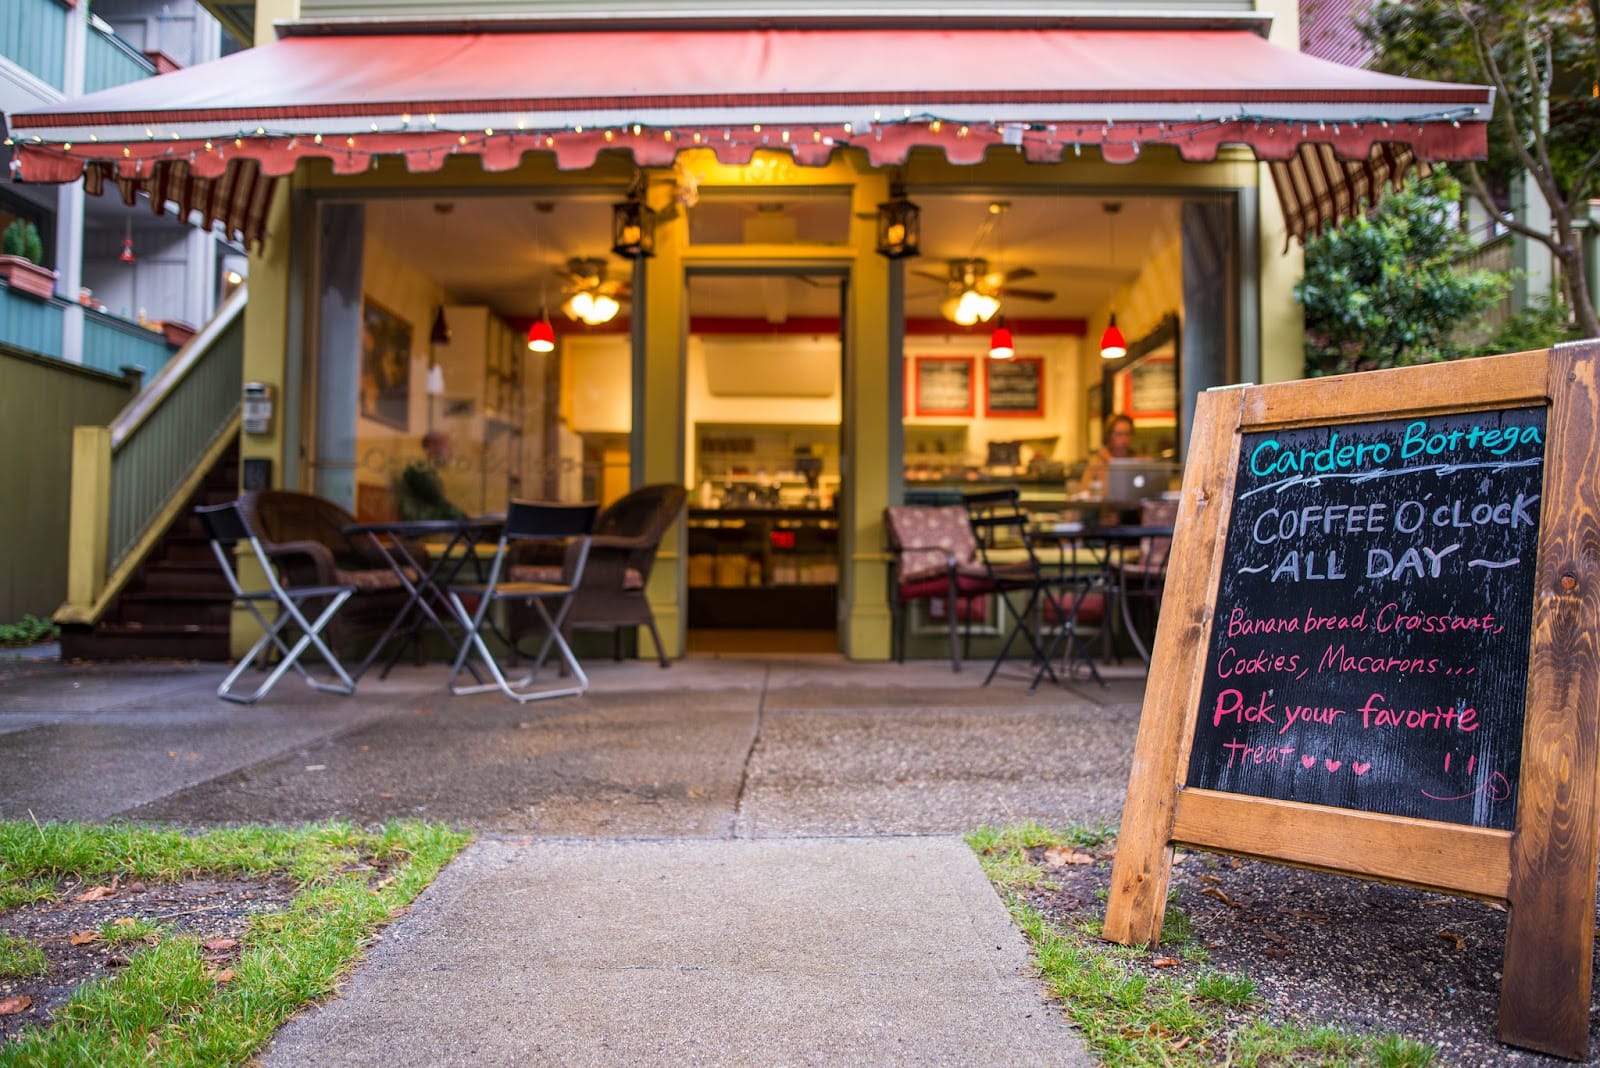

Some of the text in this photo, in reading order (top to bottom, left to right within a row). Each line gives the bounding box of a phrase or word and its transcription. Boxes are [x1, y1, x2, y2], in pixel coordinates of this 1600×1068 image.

[1251, 421, 1542, 476] Cardero Bottega
[1253, 503, 1387, 544] COFFEE
[1271, 544, 1460, 582] ALL DAY
[1227, 607, 1300, 637] Banana
[1376, 602, 1505, 634] Croissant,
[1217, 647, 1310, 680] Cookies,
[1213, 688, 1479, 734] Pick your favorite
[1222, 737, 1296, 768] treat
